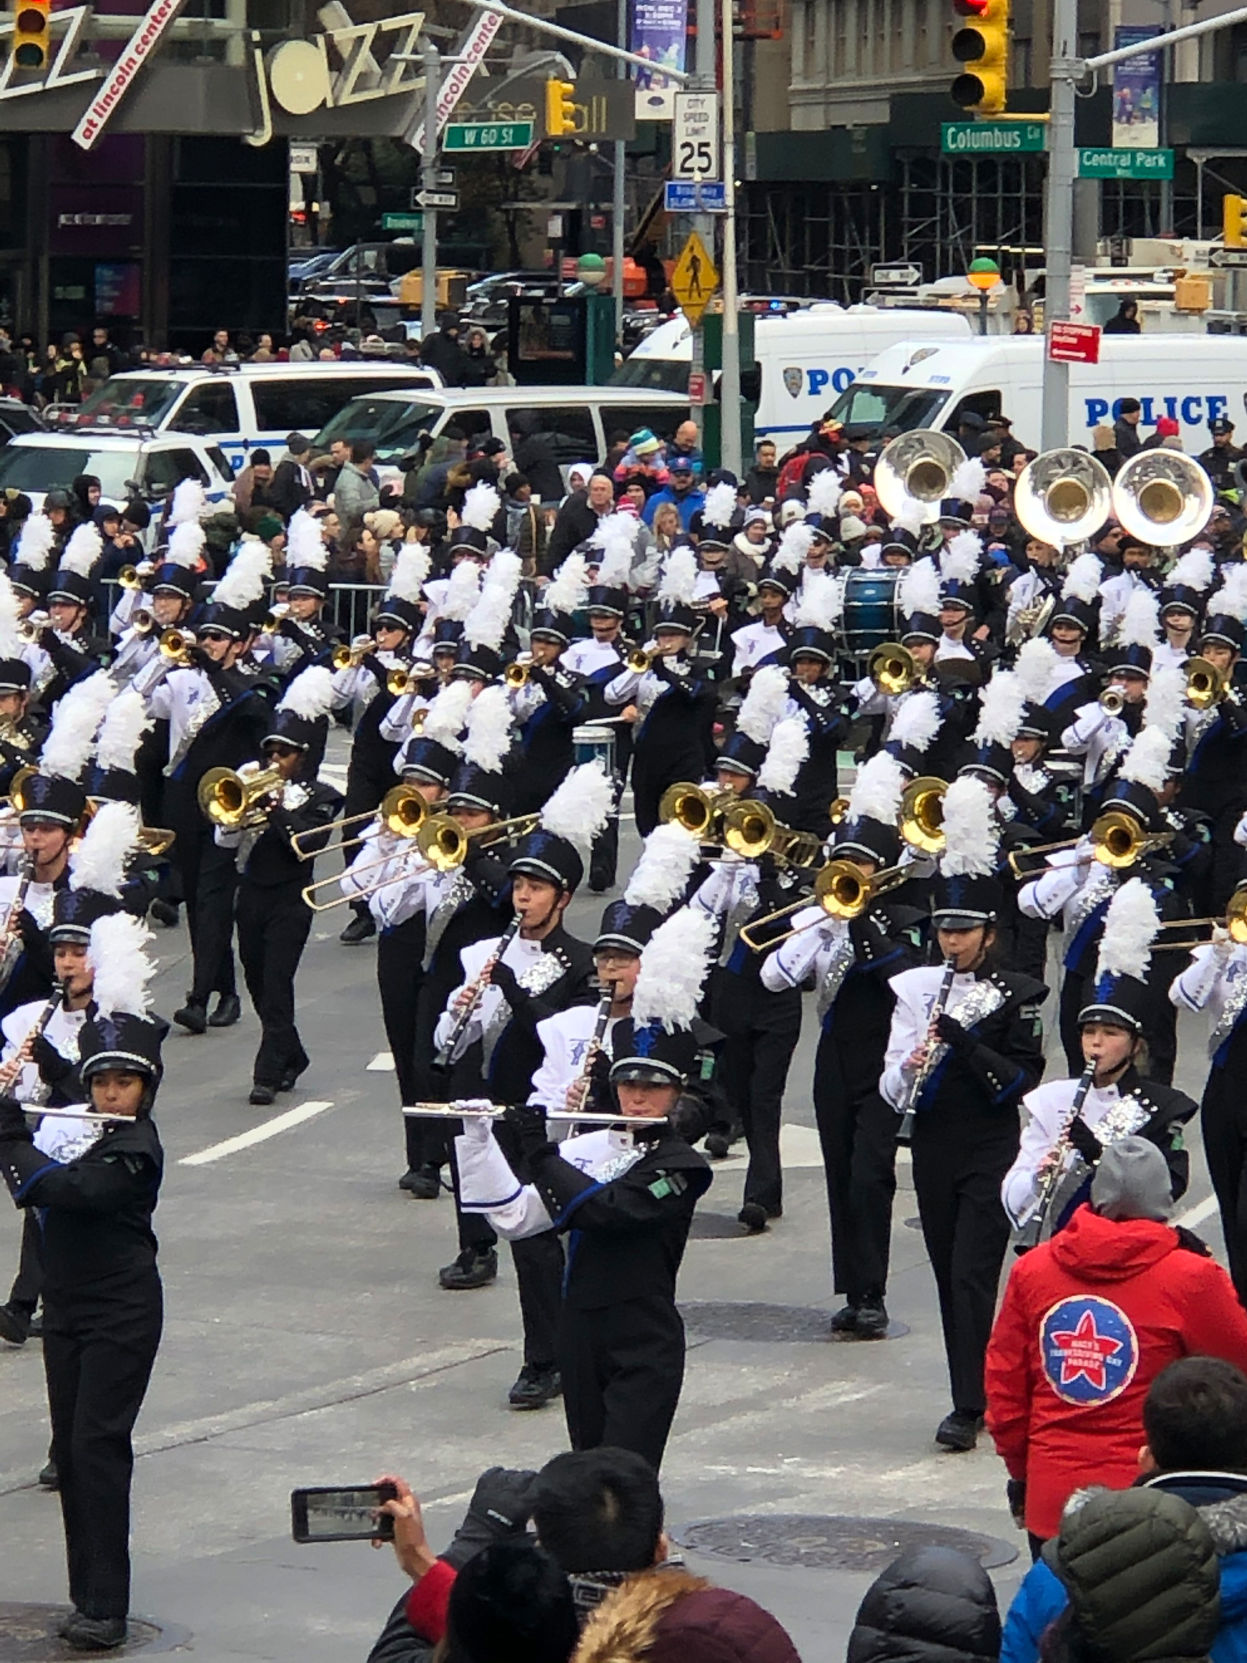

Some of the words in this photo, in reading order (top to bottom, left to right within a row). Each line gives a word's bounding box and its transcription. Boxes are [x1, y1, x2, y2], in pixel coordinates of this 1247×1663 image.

[82, 118, 99, 140] at
[92, 56, 138, 119] lincoln
[134, 0, 173, 56] center
[246, 11, 426, 147] jazz
[686, 98, 706, 109] CITY
[683, 112, 710, 123] SPEED
[464, 129, 476, 145] W
[480, 128, 497, 145] 60
[501, 127, 514, 145] St
[685, 126, 706, 137] LIMIT
[946, 126, 1021, 149] Columbus
[679, 141, 713, 174] 25
[1082, 150, 1131, 167] Central
[1135, 152, 1166, 168] Park
